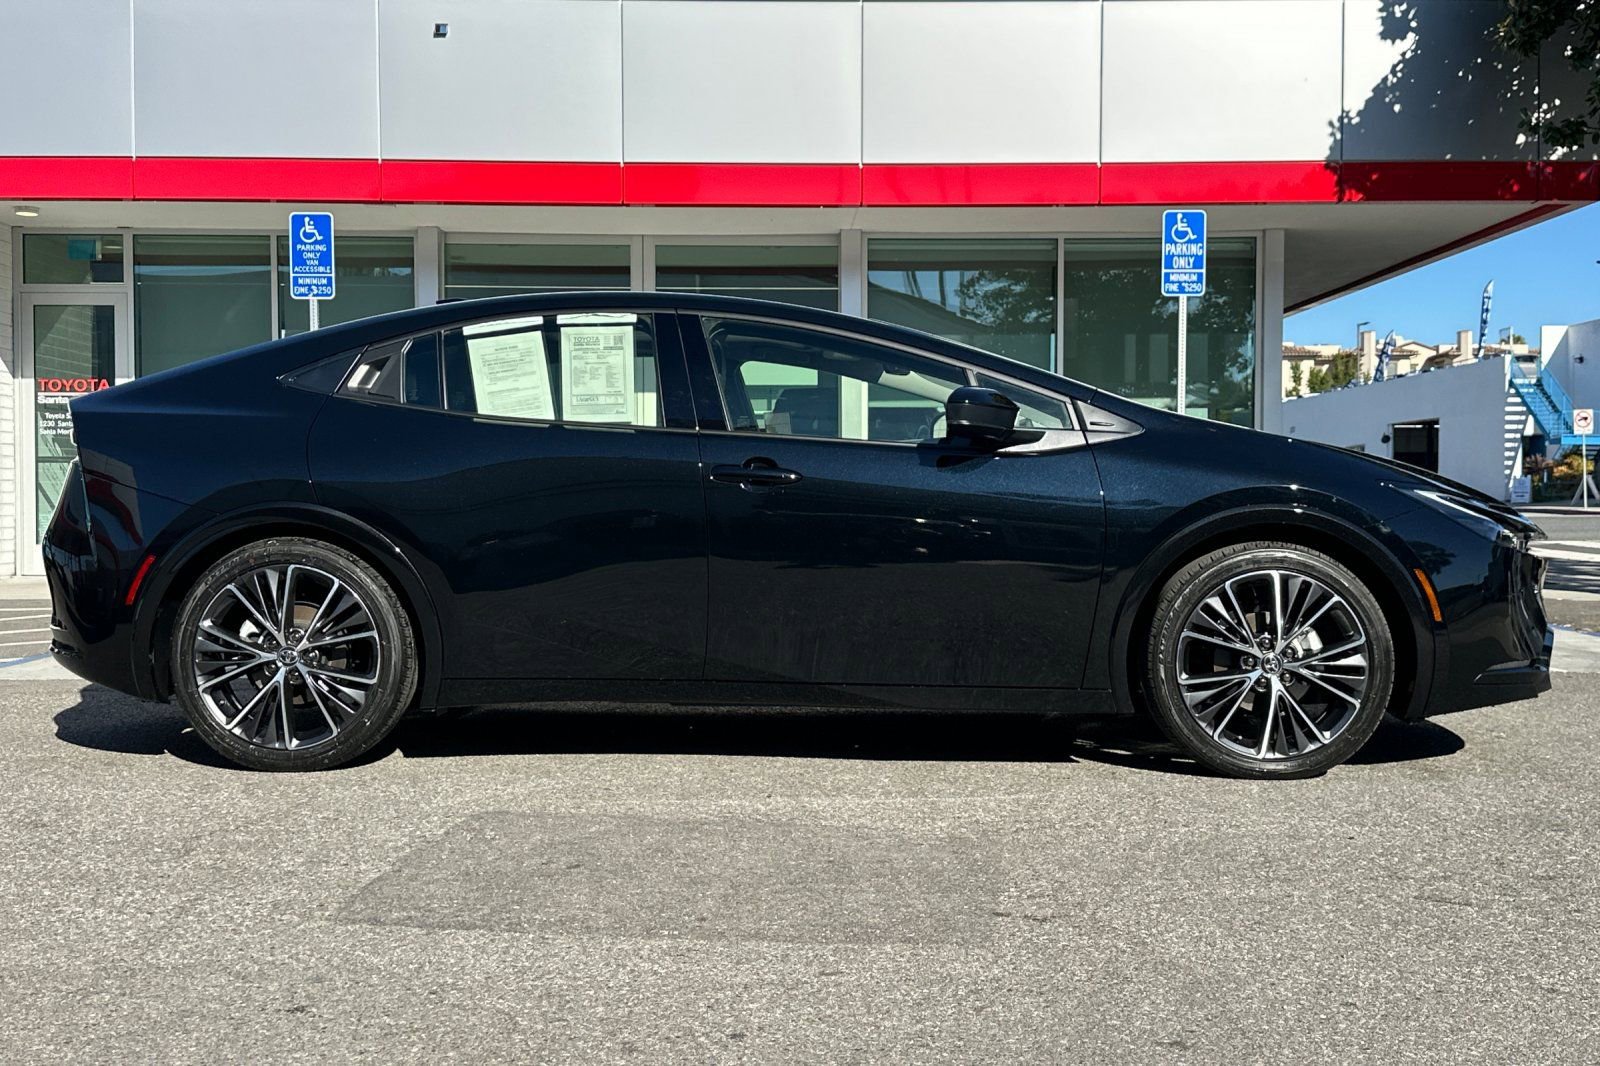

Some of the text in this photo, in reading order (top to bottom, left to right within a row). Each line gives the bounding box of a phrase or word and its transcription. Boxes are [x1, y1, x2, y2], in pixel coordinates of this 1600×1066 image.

[1165, 243, 1203, 256] PARKING
[1172, 256, 1195, 268] ONLY
[1169, 273, 1198, 282] MINIMUM
[294, 286, 308, 294] FINE
[1164, 283, 1179, 292] FINE
[38, 378, 110, 392] TOYOTA
[37, 395, 69, 404] Santa
